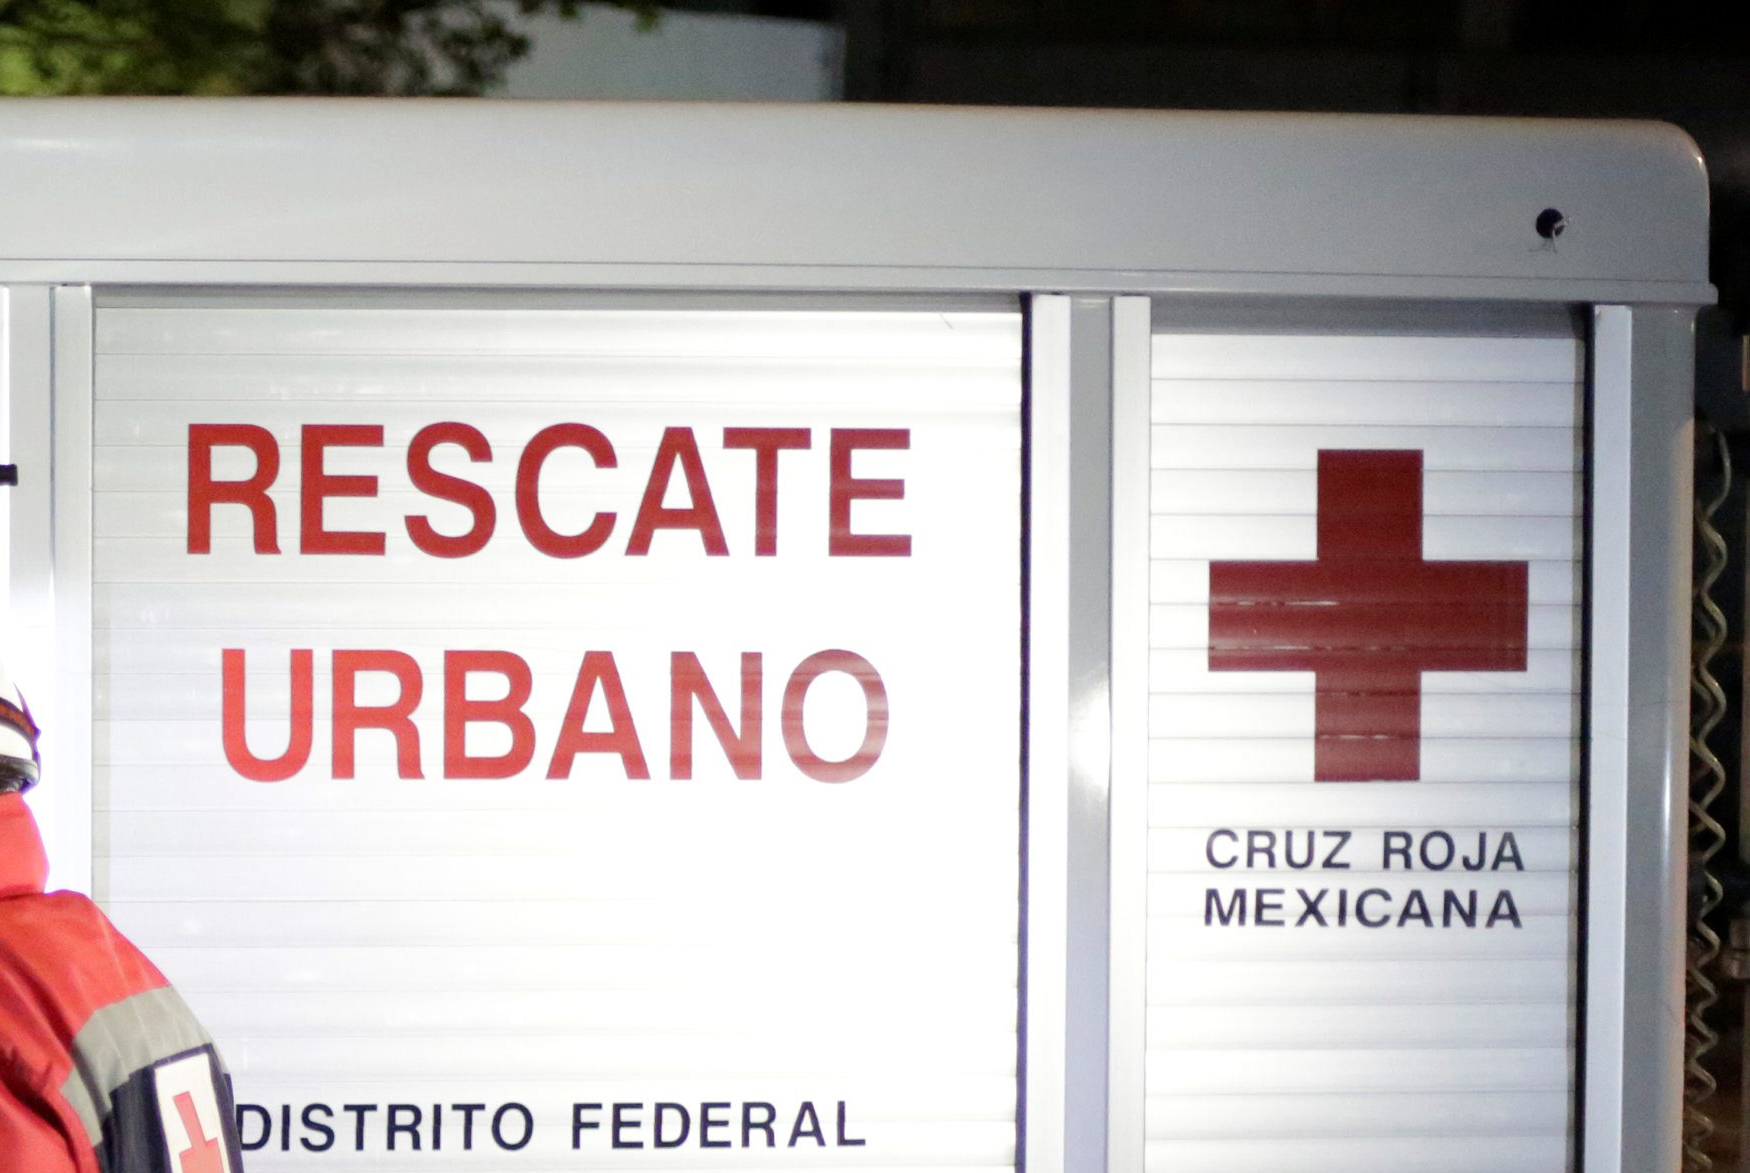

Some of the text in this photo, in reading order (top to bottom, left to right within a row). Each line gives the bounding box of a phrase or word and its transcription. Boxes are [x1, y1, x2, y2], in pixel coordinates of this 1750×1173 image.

[186, 421, 913, 560] RESCATE
[220, 648, 890, 785] URBANO
[1205, 828, 1525, 872] CRUZ ROJA
[1203, 887, 1523, 929] MEXICANA
[235, 1100, 867, 1151] DISTRITO FEDERAL
